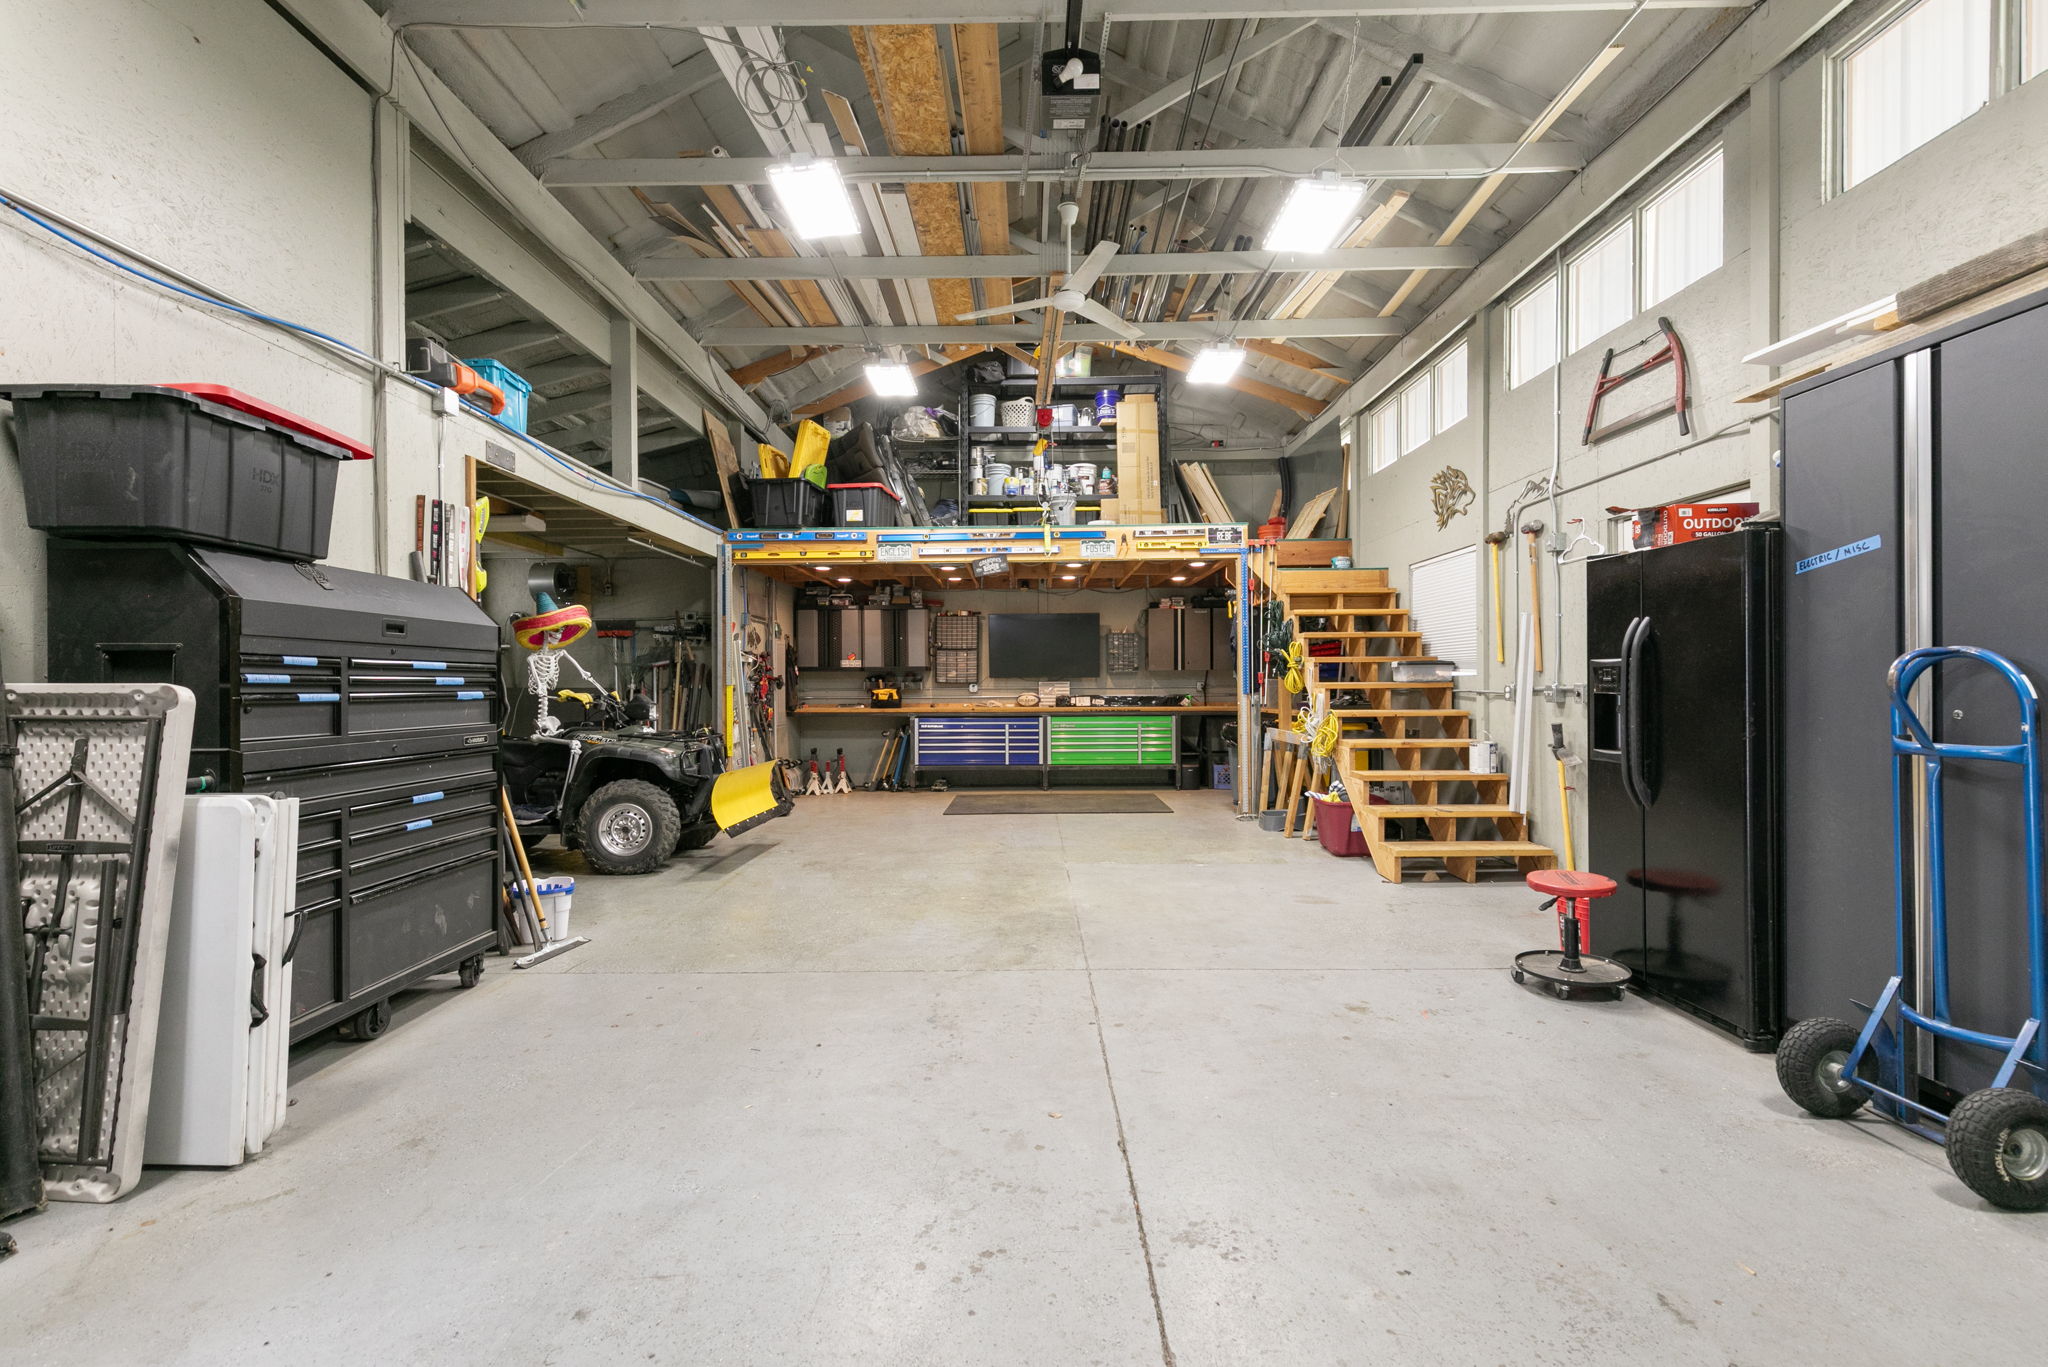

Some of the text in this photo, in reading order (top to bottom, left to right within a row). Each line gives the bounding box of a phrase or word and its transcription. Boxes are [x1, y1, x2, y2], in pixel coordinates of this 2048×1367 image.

[880, 547, 910, 557] ENGLISH
[1085, 543, 1110, 553] FOSTER
[1799, 553, 1832, 570] ELECTRIC
[1844, 542, 1870, 556] MISC
